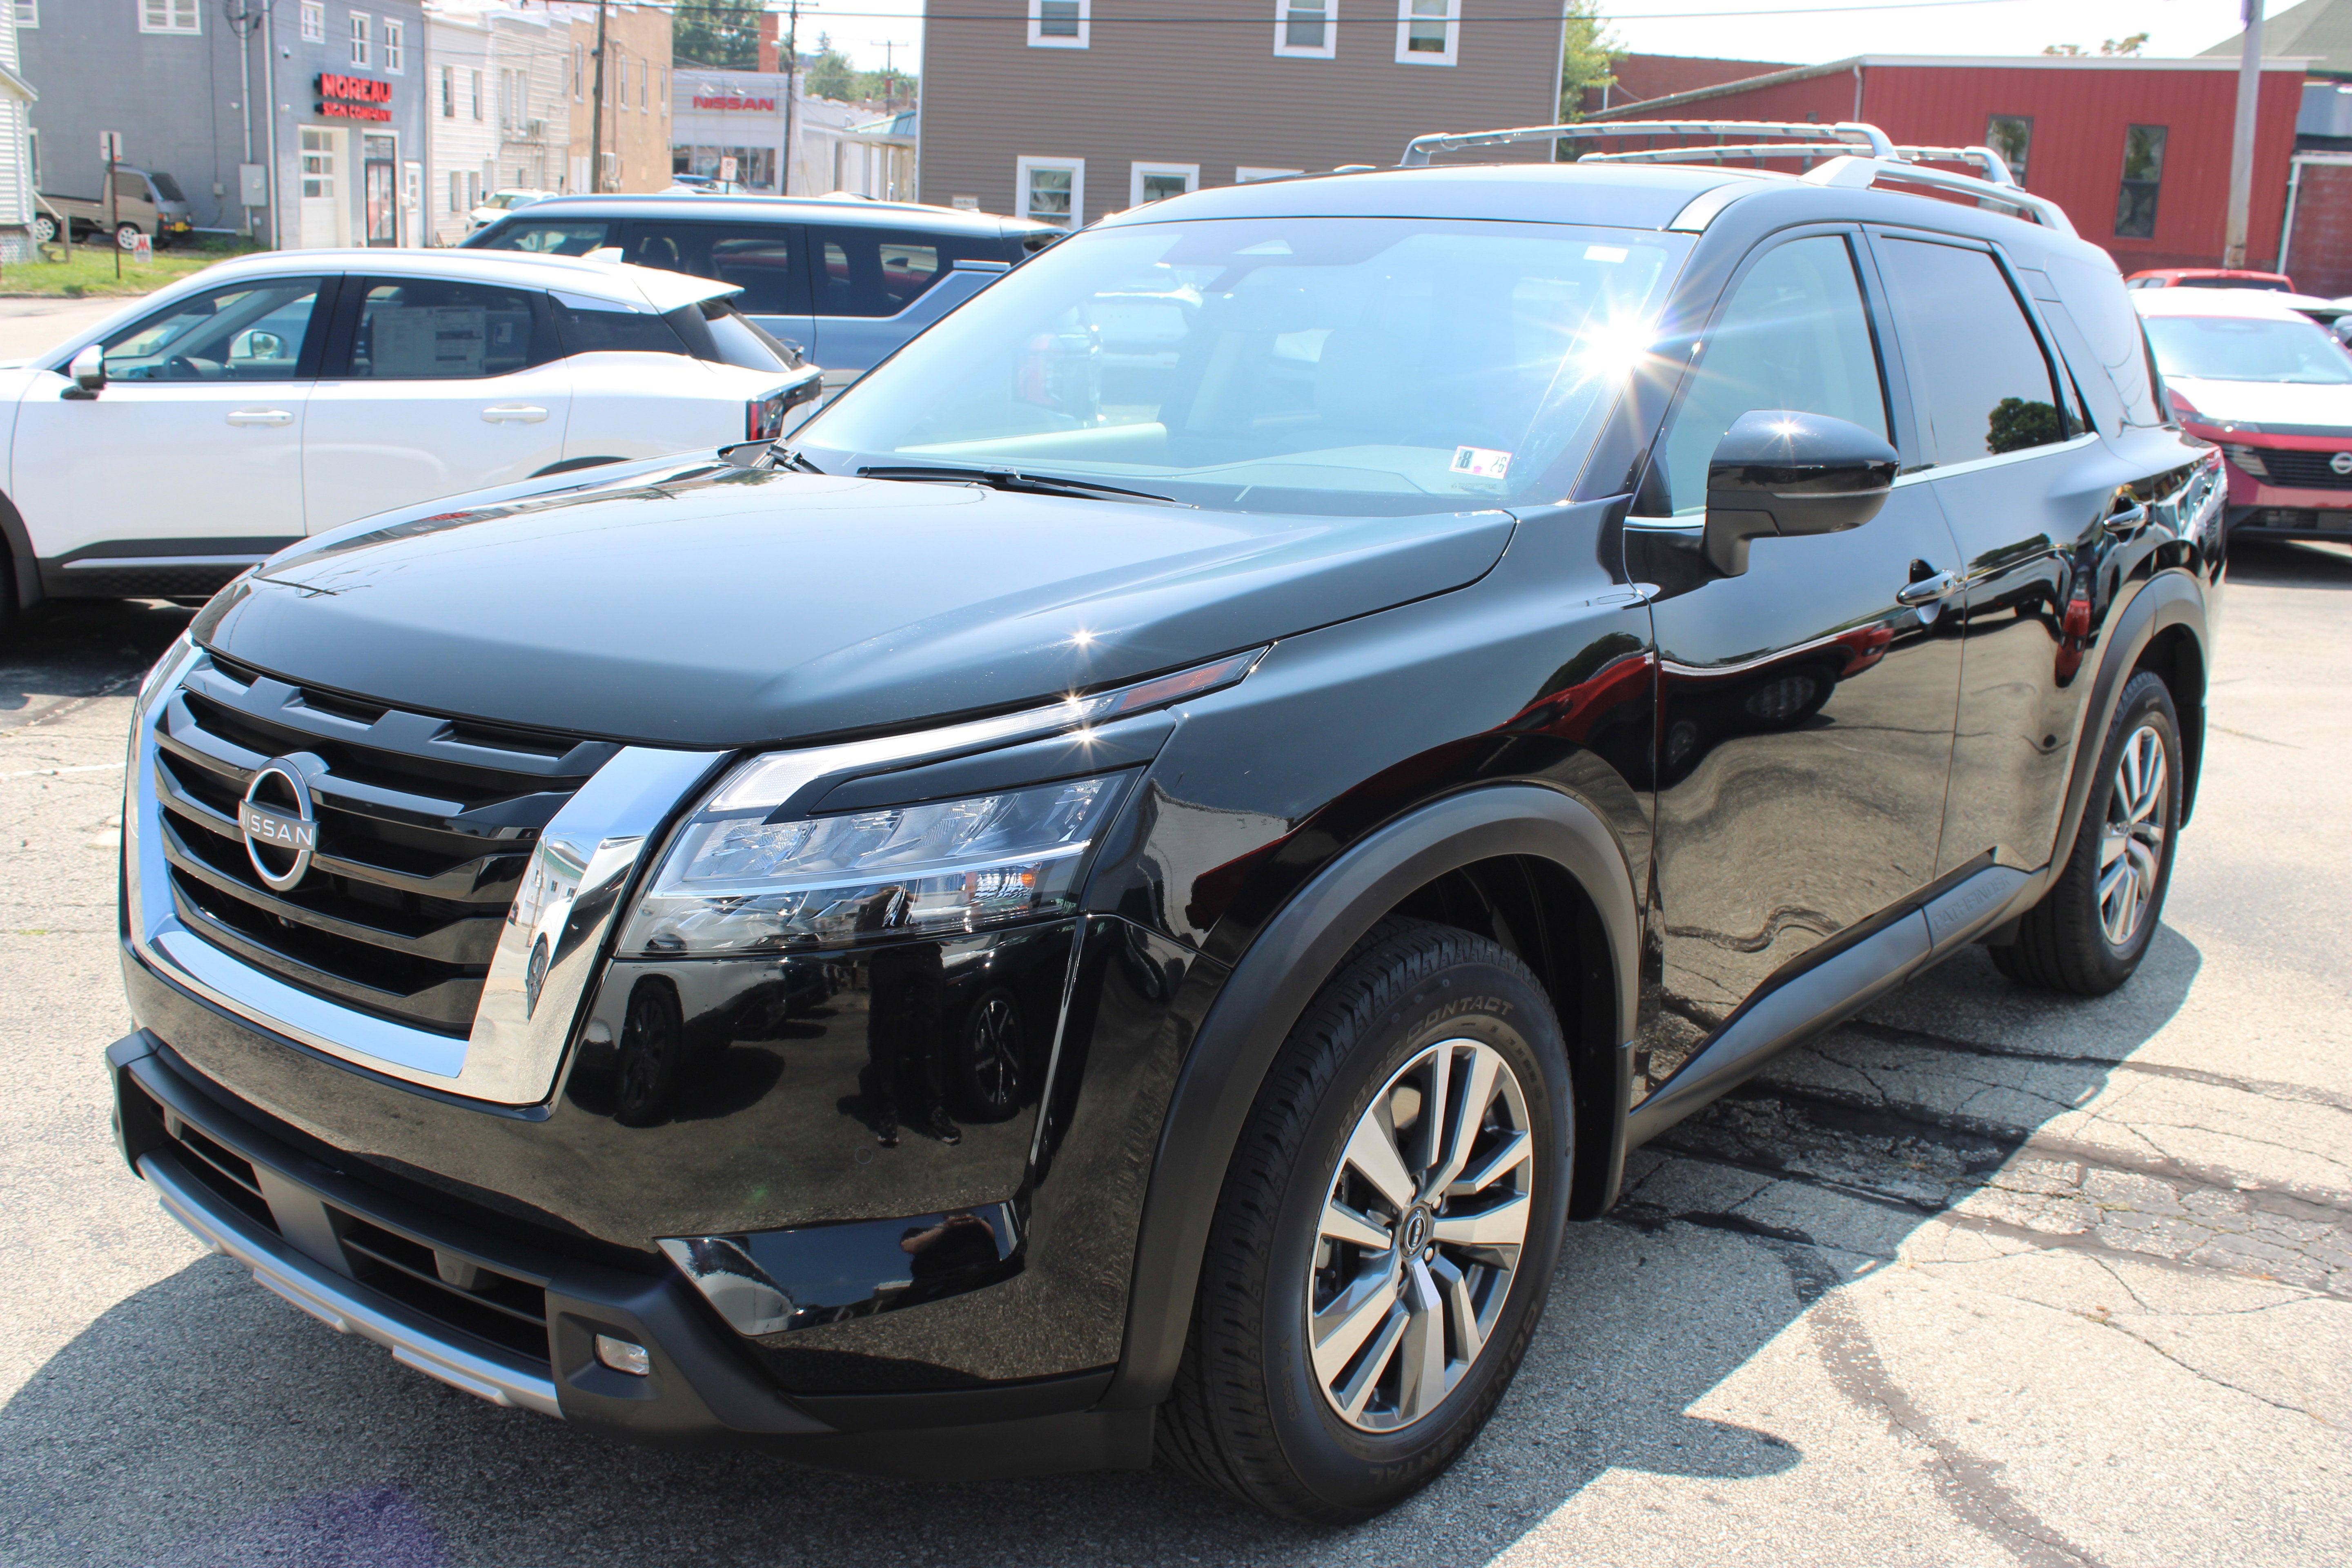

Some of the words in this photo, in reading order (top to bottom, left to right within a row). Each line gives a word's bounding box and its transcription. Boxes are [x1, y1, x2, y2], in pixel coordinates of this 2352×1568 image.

[322, 72, 392, 103] MOREAU
[323, 102, 347, 118] SIGN
[348, 104, 392, 122] COMPANY
[693, 96, 774, 111] NISSAN
[1460, 451, 1472, 468] 8
[240, 806, 313, 846] NISSAN
[1933, 873, 2011, 932] PATHFINDER
[1325, 1040, 1401, 1171] CROSS
[1406, 996, 1515, 1044] CONTACT
